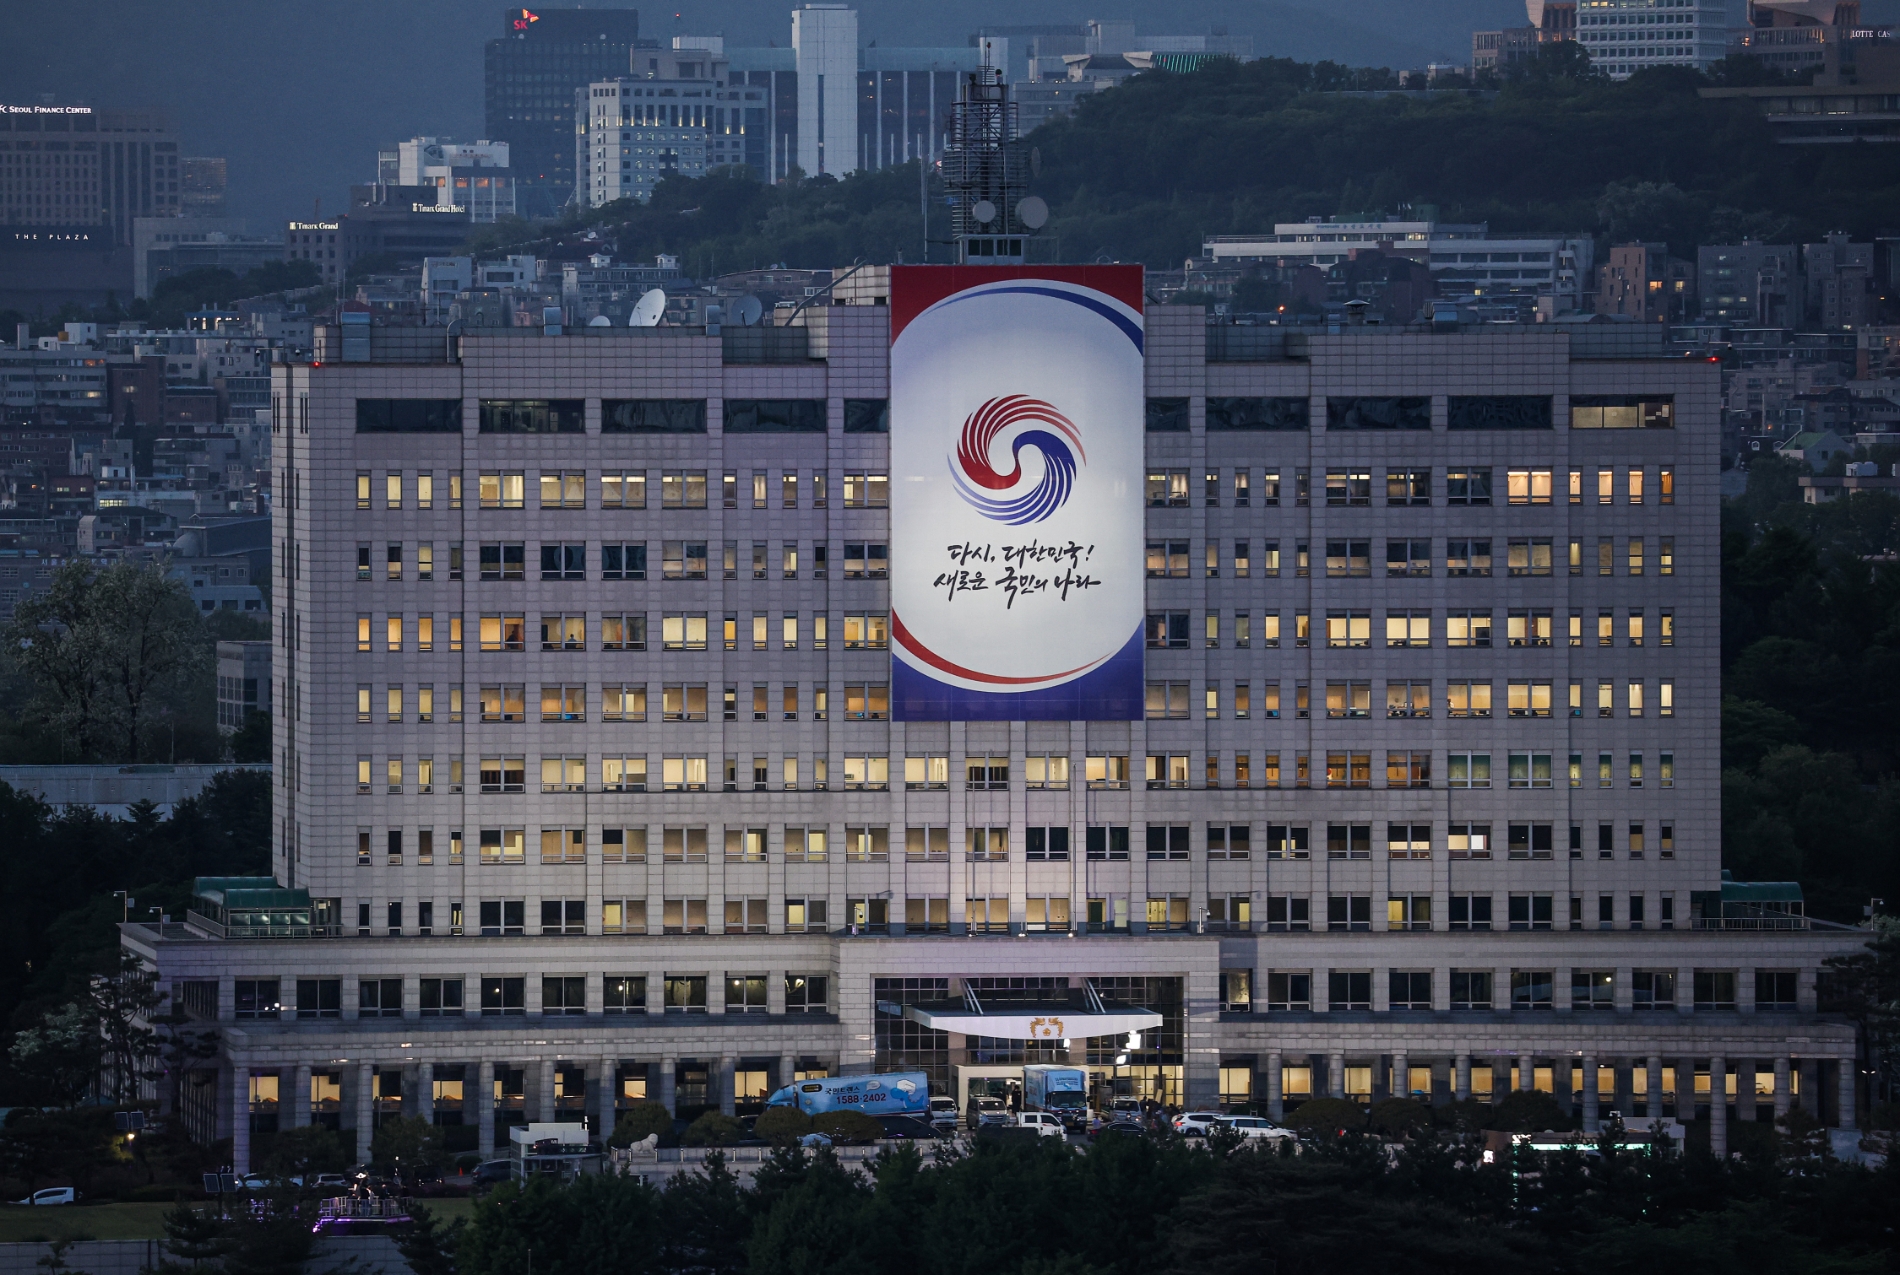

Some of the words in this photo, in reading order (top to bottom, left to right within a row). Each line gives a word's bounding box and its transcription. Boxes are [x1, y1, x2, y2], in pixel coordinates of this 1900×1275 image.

[513, 20, 528, 30] SK
[1852, 30, 1873, 38] LOTTE
[435, 203, 450, 213] Grand
[318, 222, 339, 230] Grand
[947, 541, 996, 567] 다시,
[1001, 538, 1095, 569] 대한민국!
[933, 569, 989, 602] 새로운
[995, 566, 1049, 610] 국민의
[1054, 568, 1102, 602] 나라
